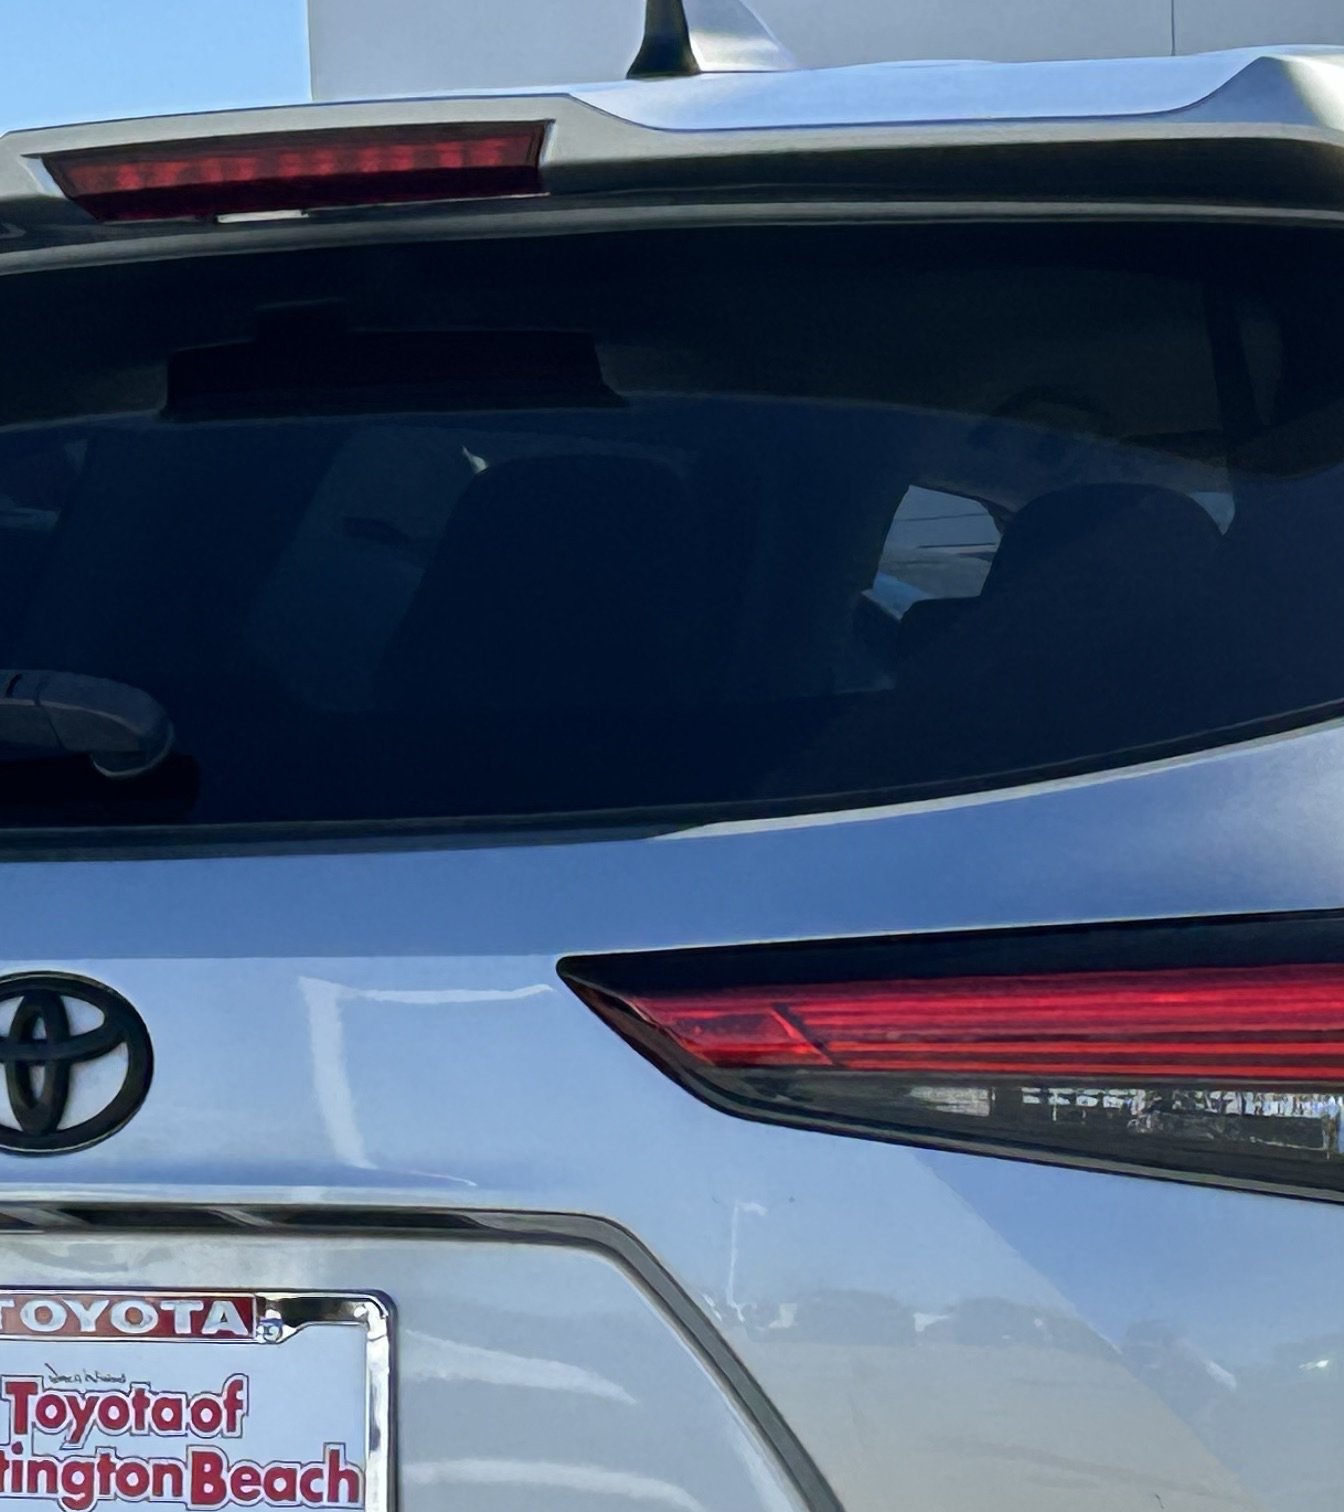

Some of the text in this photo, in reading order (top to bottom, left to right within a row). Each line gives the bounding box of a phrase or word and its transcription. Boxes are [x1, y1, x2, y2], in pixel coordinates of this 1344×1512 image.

[4, 1378, 244, 1445] Toyota of
[190, 1448, 360, 1505] Beach
